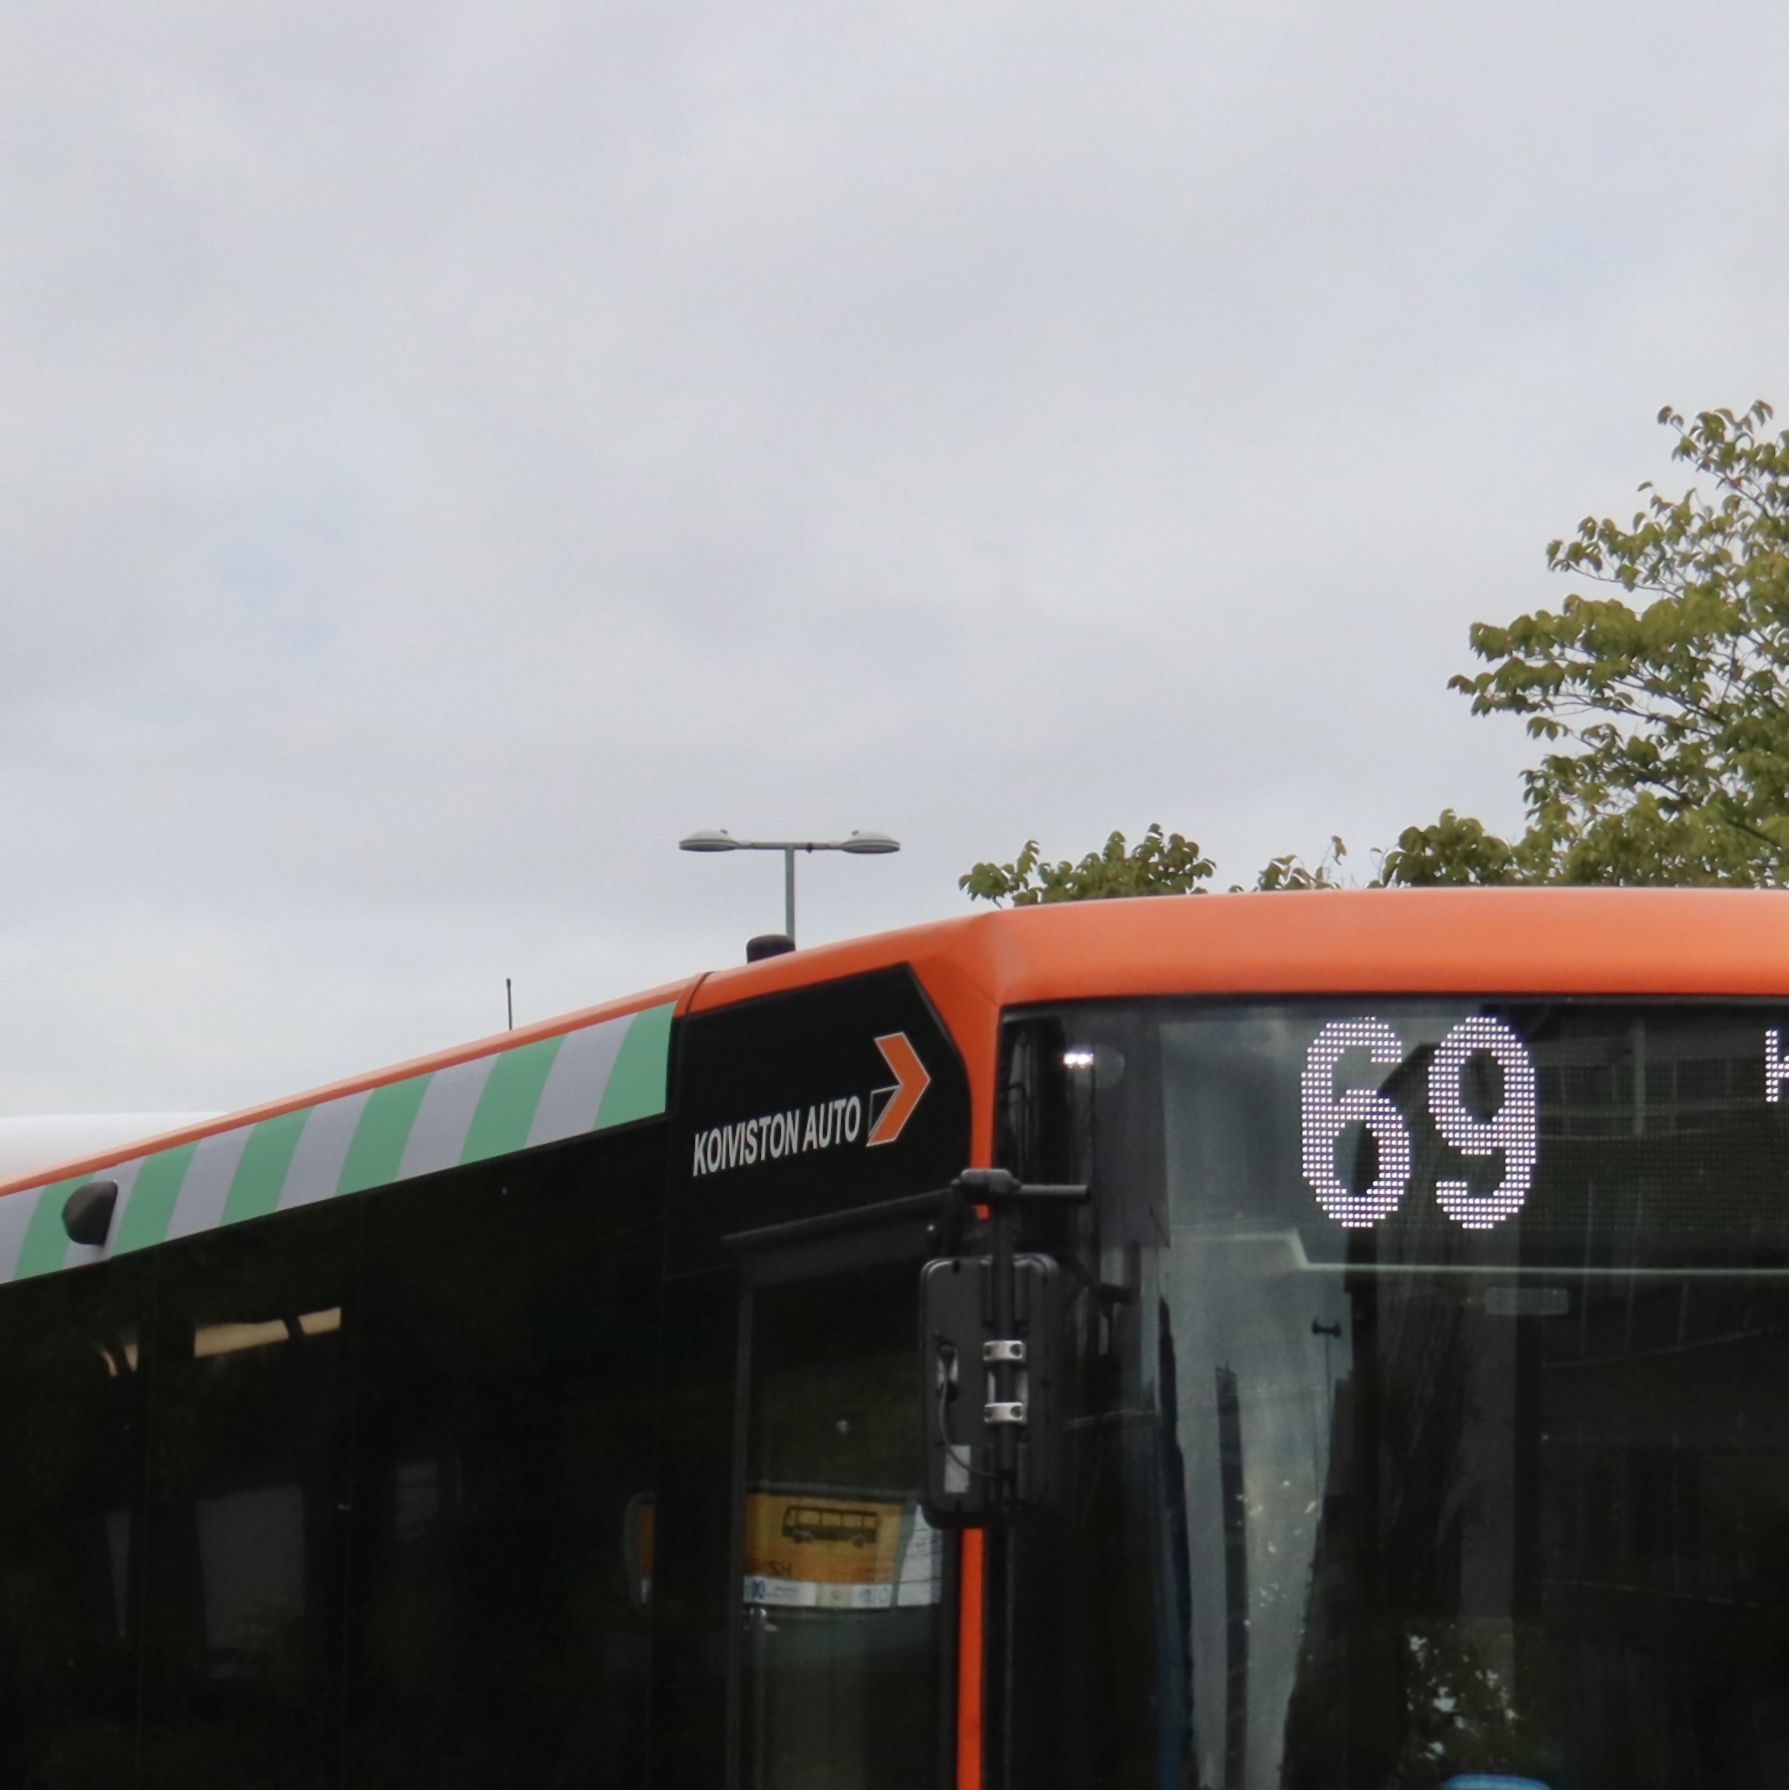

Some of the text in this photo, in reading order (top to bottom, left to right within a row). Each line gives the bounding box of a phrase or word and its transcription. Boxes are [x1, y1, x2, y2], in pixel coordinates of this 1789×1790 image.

[692, 1096, 861, 1177] KOIVISTON AUTO
[1300, 1016, 1537, 1229] 69
